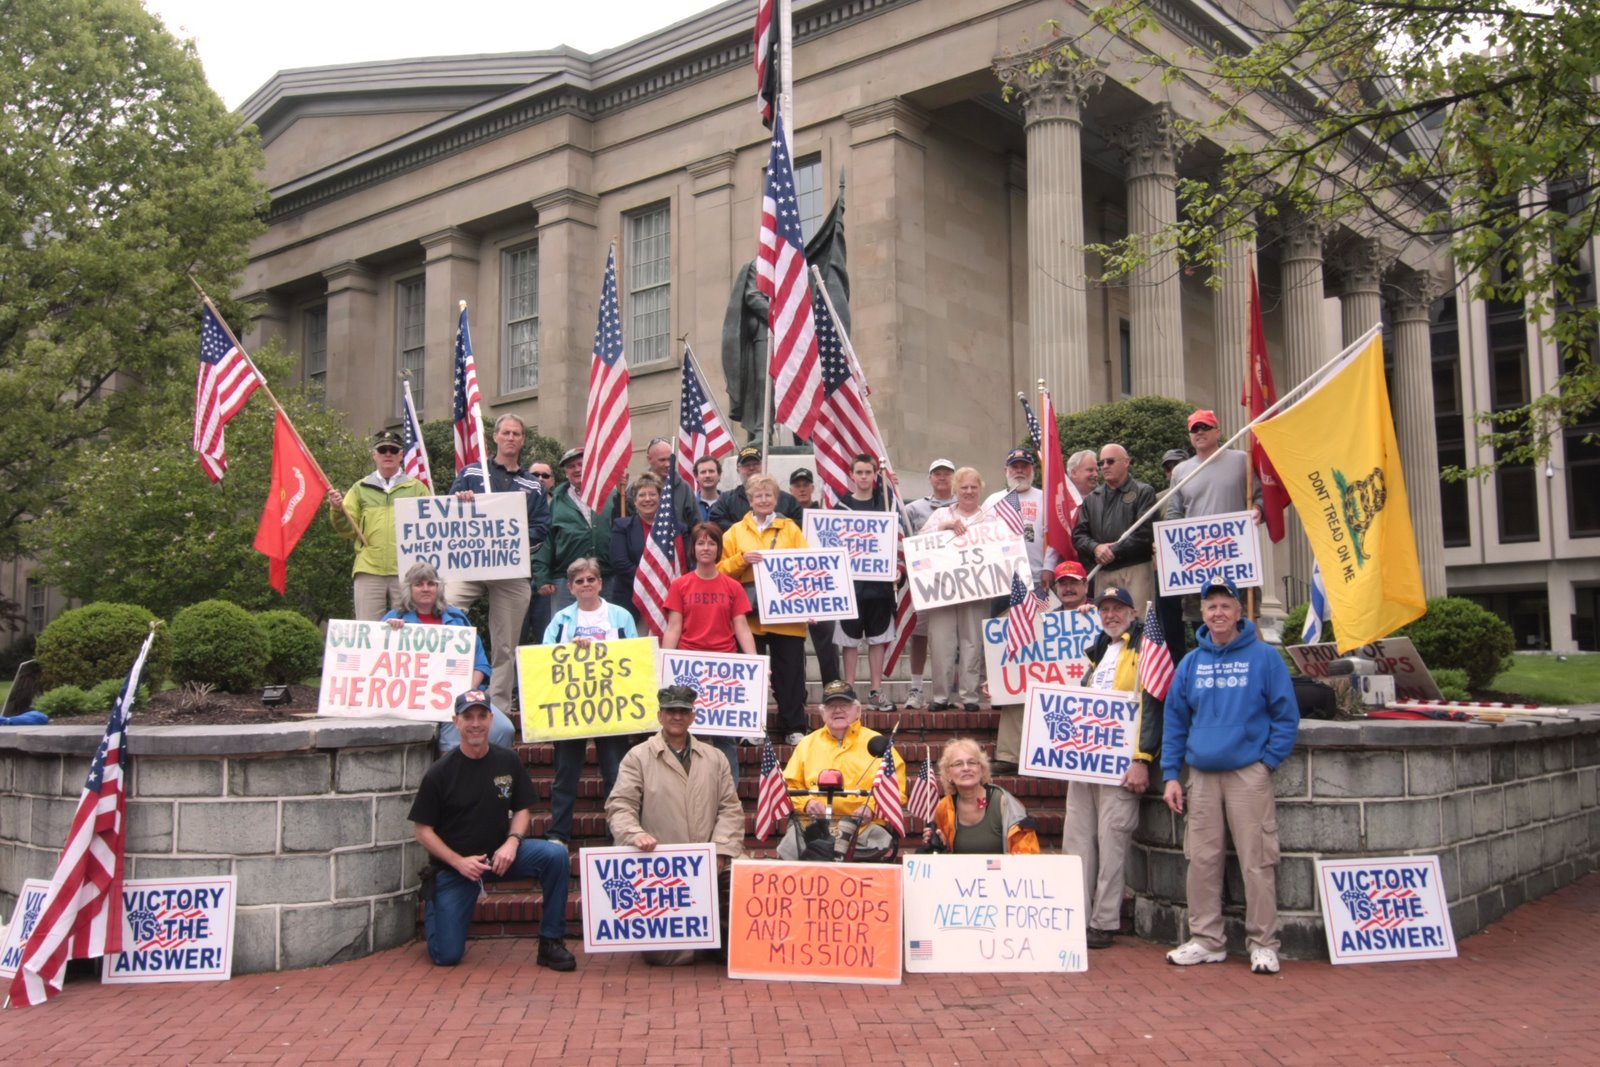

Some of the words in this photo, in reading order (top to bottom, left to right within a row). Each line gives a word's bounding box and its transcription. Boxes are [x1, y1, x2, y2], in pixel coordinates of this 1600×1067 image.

[1308, 471, 1330, 501] DONT
[417, 498, 487, 519] EVIL
[403, 519, 520, 540] FLOURISHES
[813, 517, 889, 533] VICTORY
[1165, 520, 1246, 544] VICTORY
[1323, 503, 1344, 542] TREAD
[400, 541, 442, 555] WHEN
[447, 539, 485, 550] GOOD
[491, 538, 521, 549] MEN
[822, 538, 840, 548] IS
[845, 538, 878, 553] THE
[910, 533, 946, 551] THE
[1179, 548, 1196, 564] IS
[1201, 543, 1239, 561] THE
[447, 549, 521, 569] NOTHING
[764, 555, 840, 572] VICTORY
[959, 548, 984, 566] IS
[1337, 545, 1352, 563] ON
[850, 559, 889, 573] WER!
[1169, 563, 1253, 587] ANSWER!
[1343, 564, 1356, 583] ME
[777, 579, 794, 593] IS
[799, 576, 835, 592] THE
[914, 556, 1032, 603] WORKING
[768, 596, 849, 615] ANSWER!
[1043, 608, 1103, 638] BLES
[330, 623, 371, 649] OUR
[381, 625, 471, 654] TROOPS
[1364, 641, 1385, 658] OF
[551, 643, 608, 663] GOD
[1001, 635, 1101, 666] AMERIC
[369, 652, 430, 678] ARE
[551, 658, 631, 684] BLESS
[670, 659, 758, 680] VICTORY
[565, 679, 614, 700] OUR
[1002, 662, 1065, 695] USA
[328, 676, 453, 710] HEROES
[705, 685, 746, 703] THE
[538, 693, 646, 728] TROOPS
[694, 708, 758, 728] SWER!
[1040, 693, 1140, 722] VICTORY
[1049, 722, 1071, 741] IS
[1080, 724, 1125, 747] THE
[1031, 747, 1130, 775] ANSWER
[595, 856, 703, 880] VICTORY
[907, 860, 931, 882] 9/11
[1331, 867, 1429, 891] VICTORY
[752, 873, 829, 896] PROUD
[841, 877, 873, 897] OF
[955, 878, 988, 898] WE
[1003, 878, 1055, 899] WILL
[123, 888, 224, 911] VICTORY
[611, 888, 634, 909] IS
[643, 886, 691, 908] THE
[1350, 901, 1371, 920] IS
[1376, 897, 1424, 919] THE
[746, 897, 792, 918] OUR
[806, 898, 889, 922] TROOPS
[934, 904, 998, 928] NEVER
[1005, 905, 1074, 931] FORGET
[133, 920, 156, 941] IS
[164, 918, 209, 940] THE
[596, 916, 709, 940] ANSWER!
[746, 920, 790, 940] AND
[805, 921, 869, 943] THEIR
[1341, 926, 1444, 951] ANSWER!
[115, 948, 222, 972] ANSWER!
[769, 943, 874, 968] MISSION
[979, 938, 1035, 960] USA
[1058, 951, 1081, 971] 9/11
